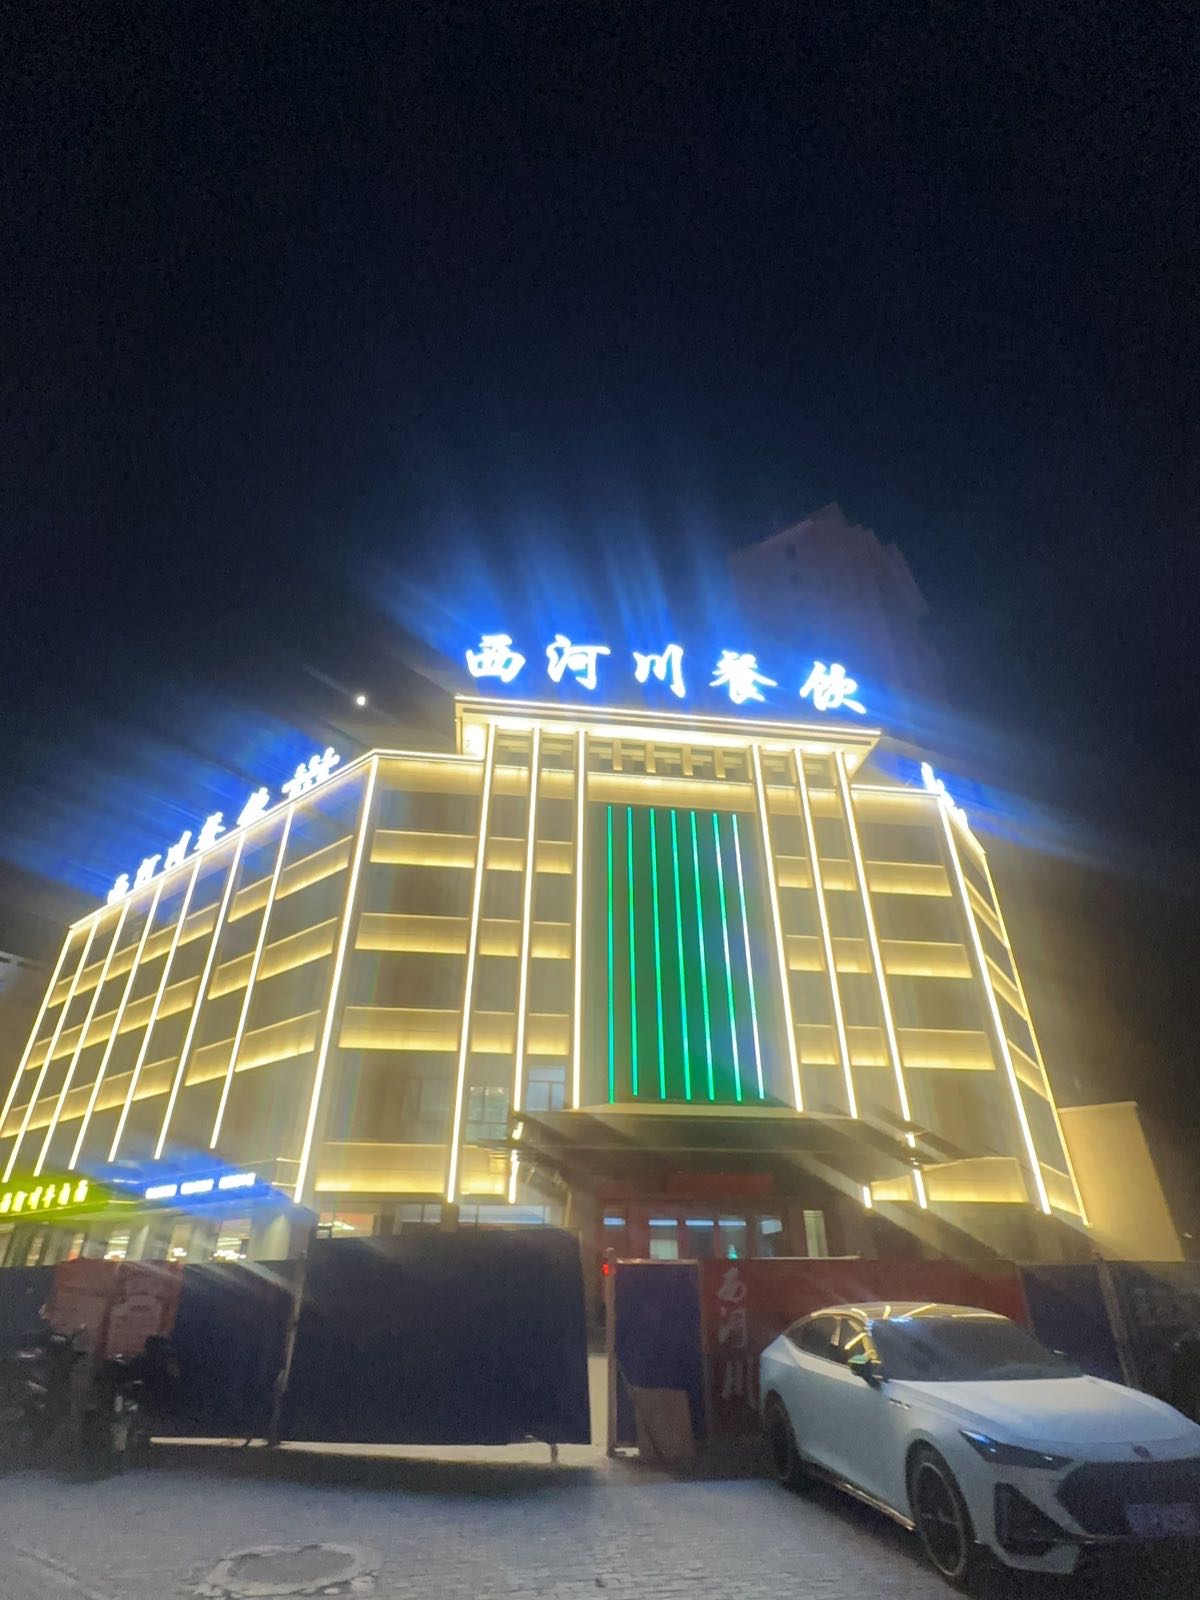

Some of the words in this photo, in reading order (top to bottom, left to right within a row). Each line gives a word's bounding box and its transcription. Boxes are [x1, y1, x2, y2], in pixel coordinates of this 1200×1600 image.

[465, 633, 867, 714] 西河川餐饮
